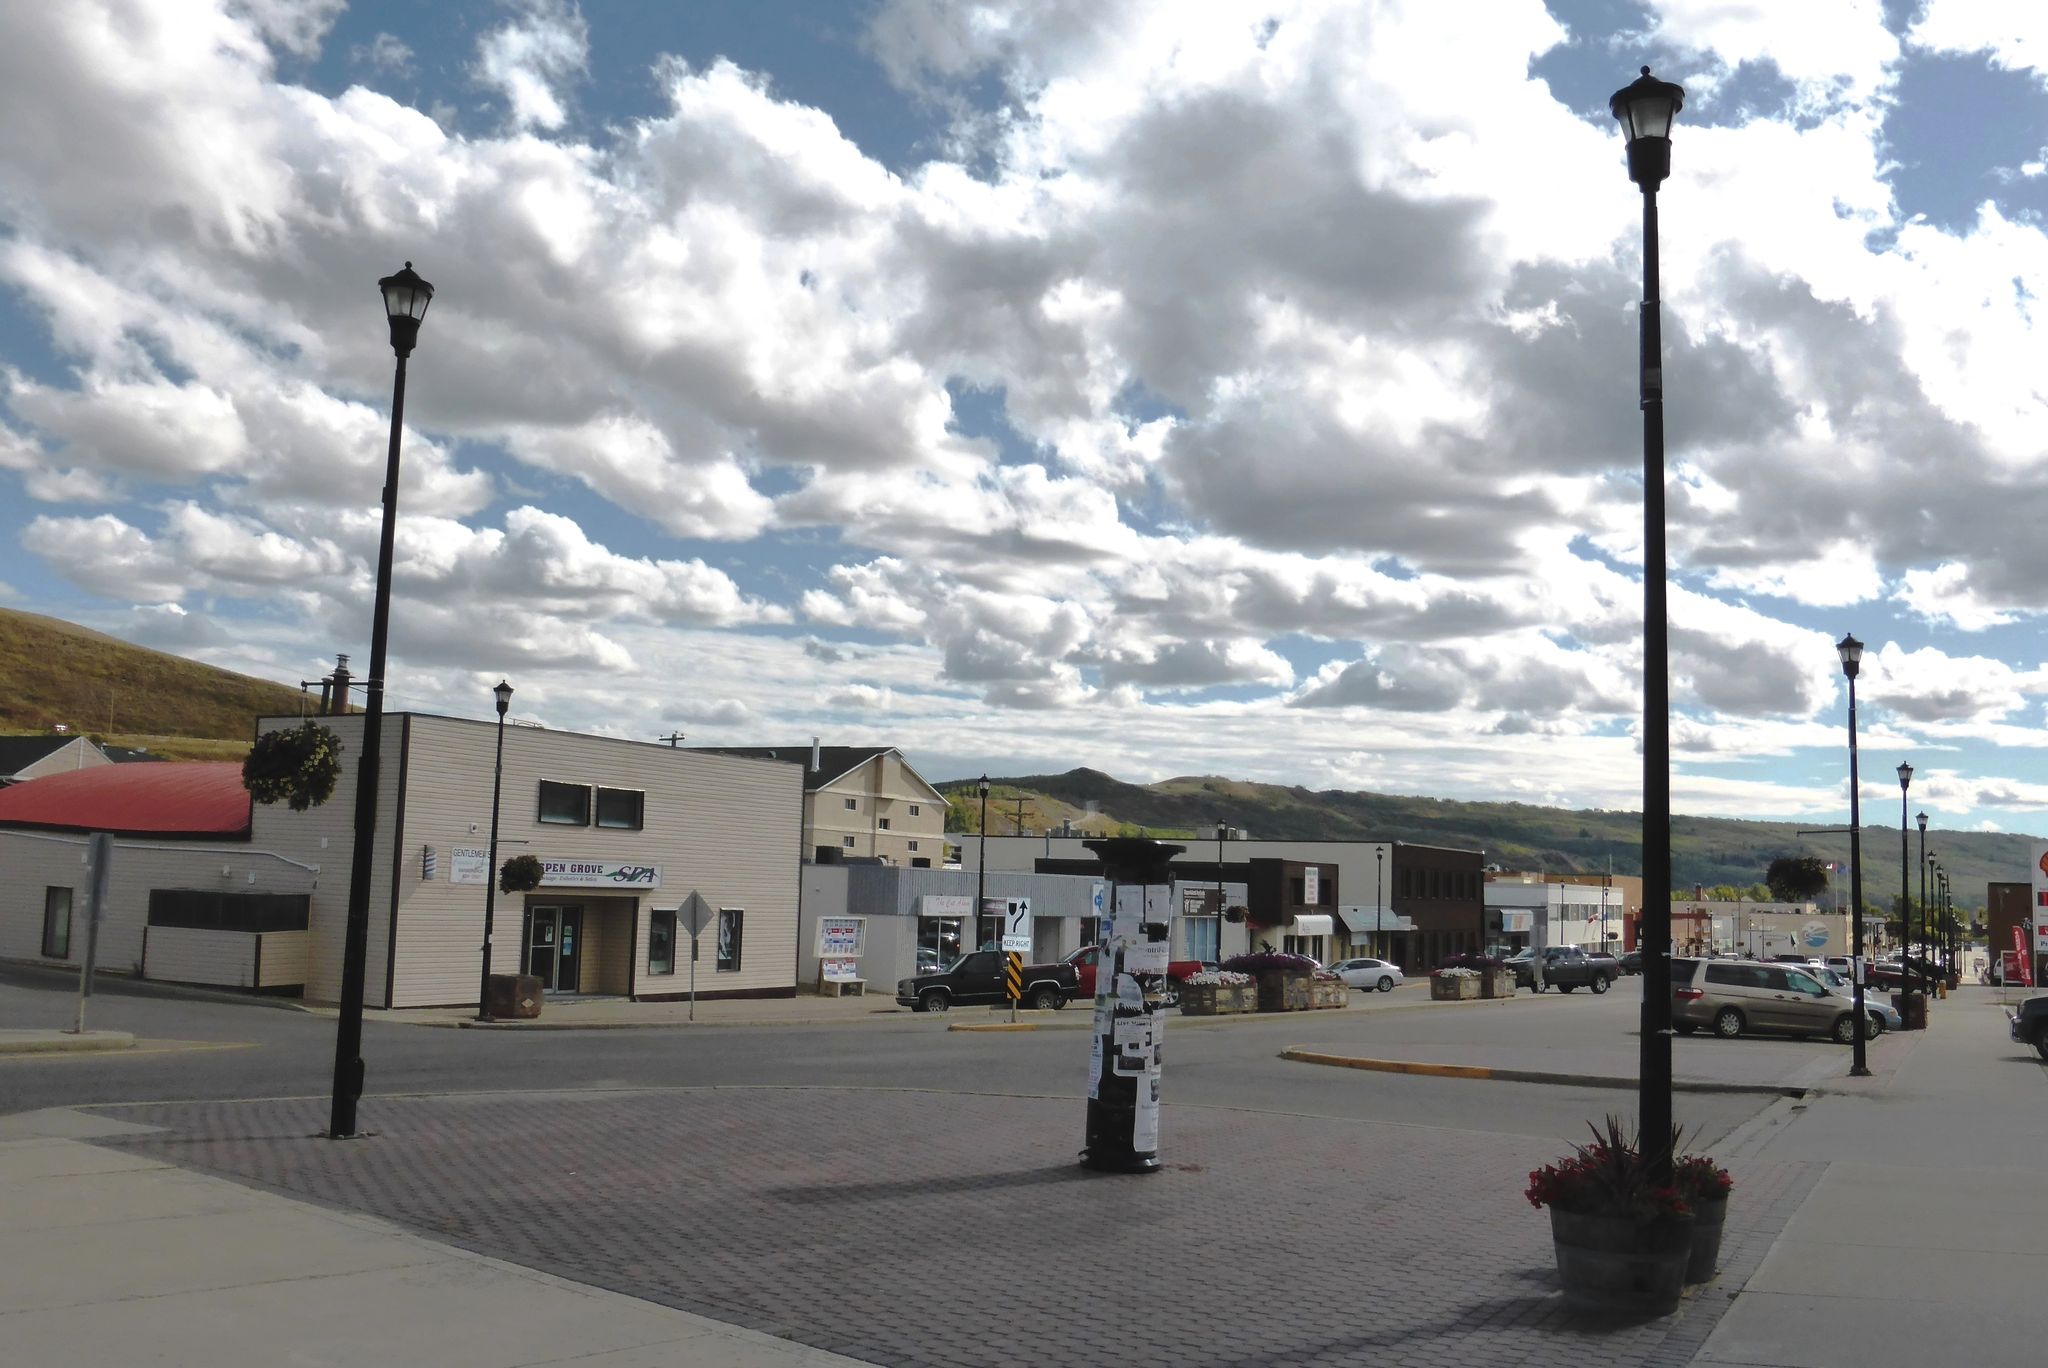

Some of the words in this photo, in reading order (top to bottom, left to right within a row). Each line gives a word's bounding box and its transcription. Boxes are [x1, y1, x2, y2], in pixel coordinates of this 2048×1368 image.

[453, 848, 491, 859] GENTLEMES
[541, 863, 566, 873] SPEN
[570, 864, 603, 874] GROVE
[613, 866, 656, 883] SPA
[1003, 939, 1015, 947] KEEP
[1016, 940, 1030, 948] RIGHT
